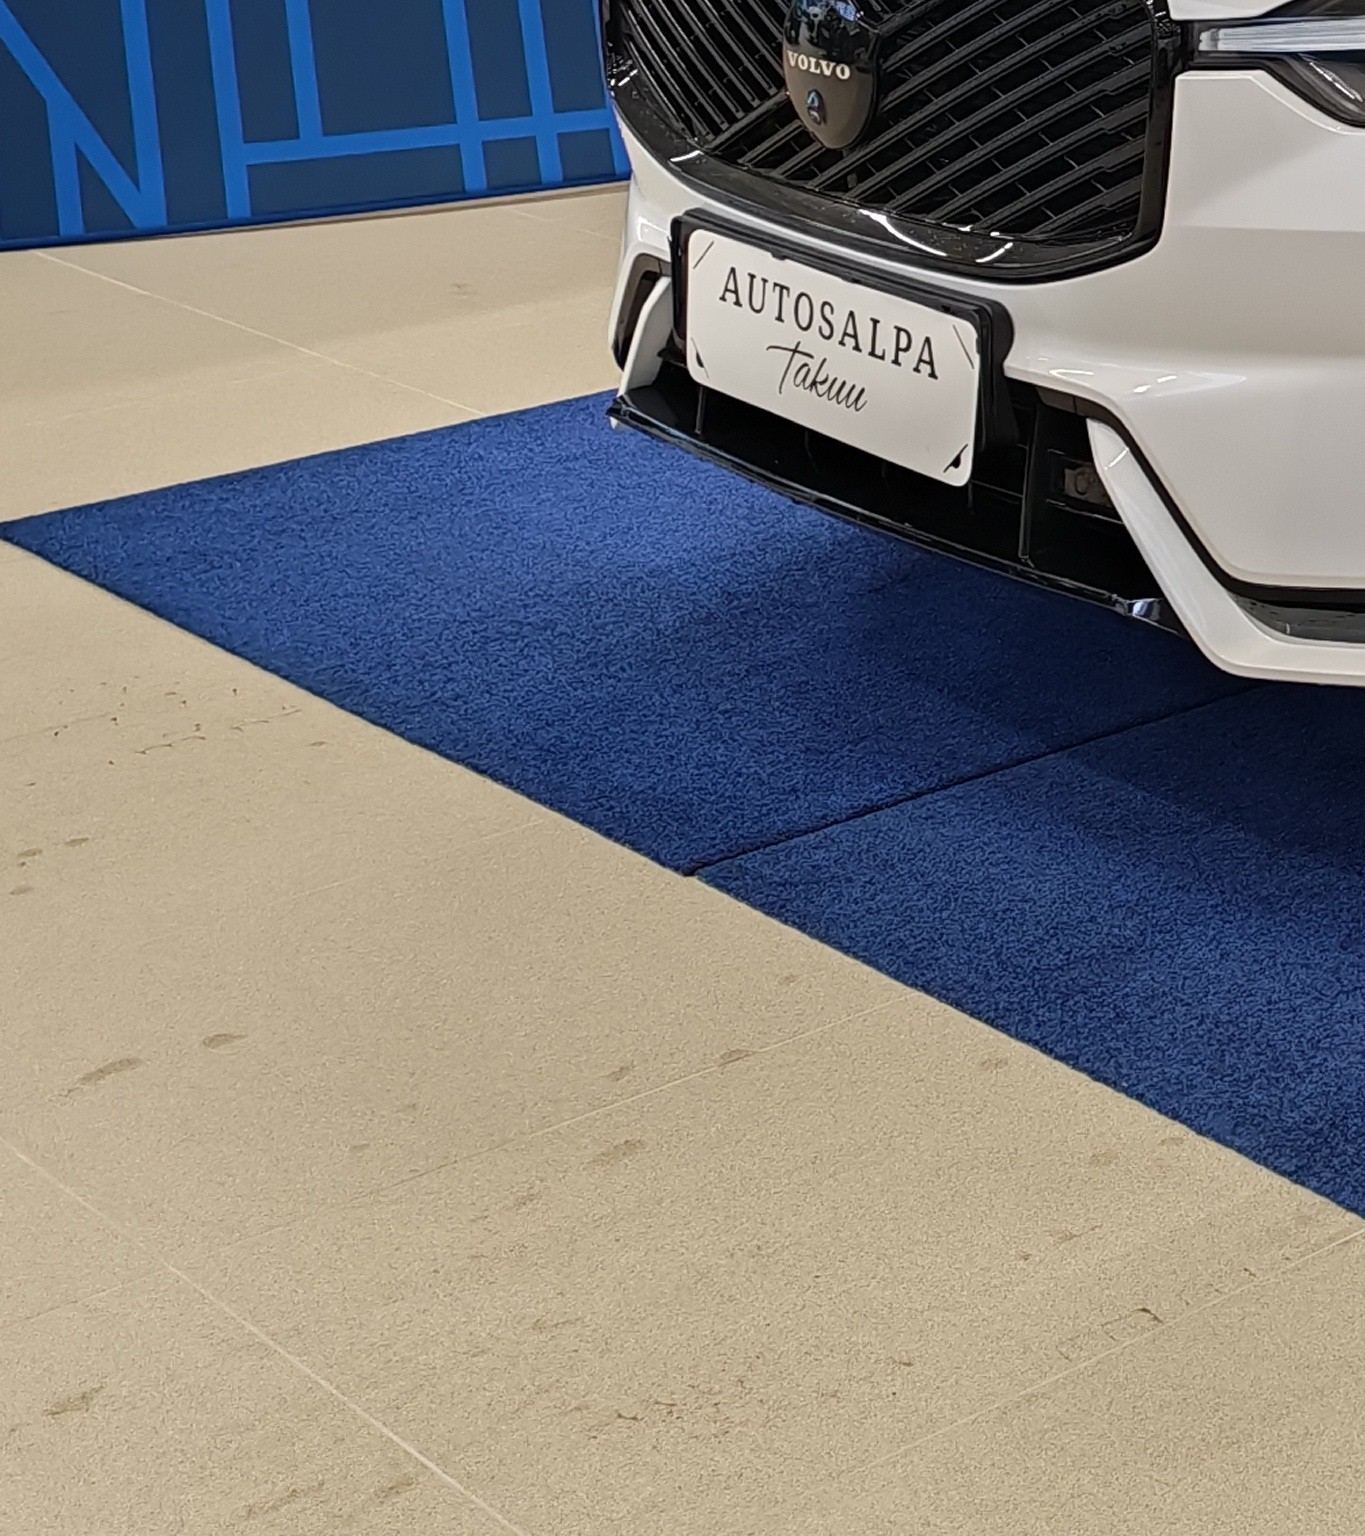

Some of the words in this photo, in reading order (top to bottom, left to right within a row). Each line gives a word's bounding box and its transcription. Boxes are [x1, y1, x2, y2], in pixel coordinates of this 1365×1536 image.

[786, 50, 851, 80] VOLVO
[719, 266, 939, 380] AUTOSALPA
[765, 340, 868, 412] Takuu
